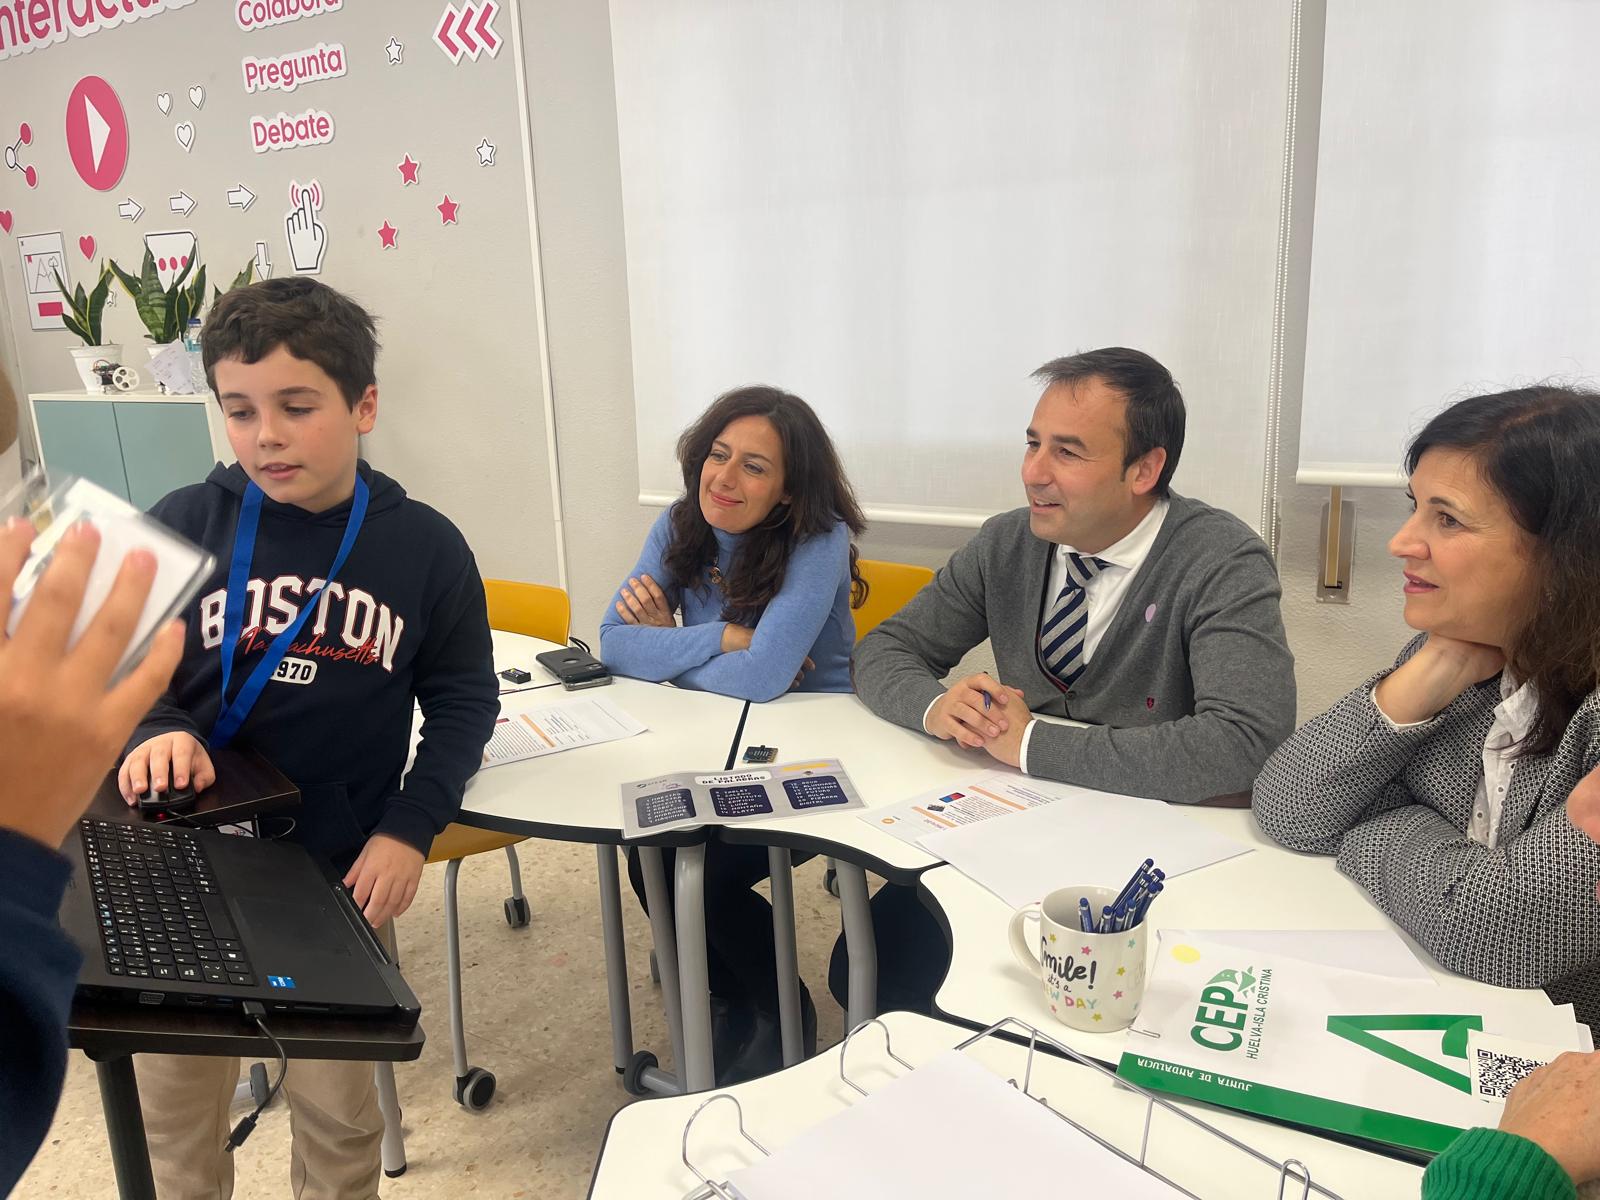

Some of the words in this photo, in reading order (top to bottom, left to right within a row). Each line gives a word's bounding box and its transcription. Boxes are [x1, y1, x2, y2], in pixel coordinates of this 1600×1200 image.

[238, 0, 339, 26] Colabo
[244, 48, 343, 88] Pregunta
[252, 114, 331, 147] Debate
[272, 660, 313, 681] 970
[1063, 984, 1072, 993] a
[1256, 968, 1273, 1005] CRISTINA
[1065, 995, 1098, 1010] DAY
[1190, 985, 1249, 1052] CEP
[1246, 1007, 1267, 1060] HUELVA-ISLA
[1198, 1072, 1212, 1083] DE
[1217, 1076, 1253, 1092] JUNTA
